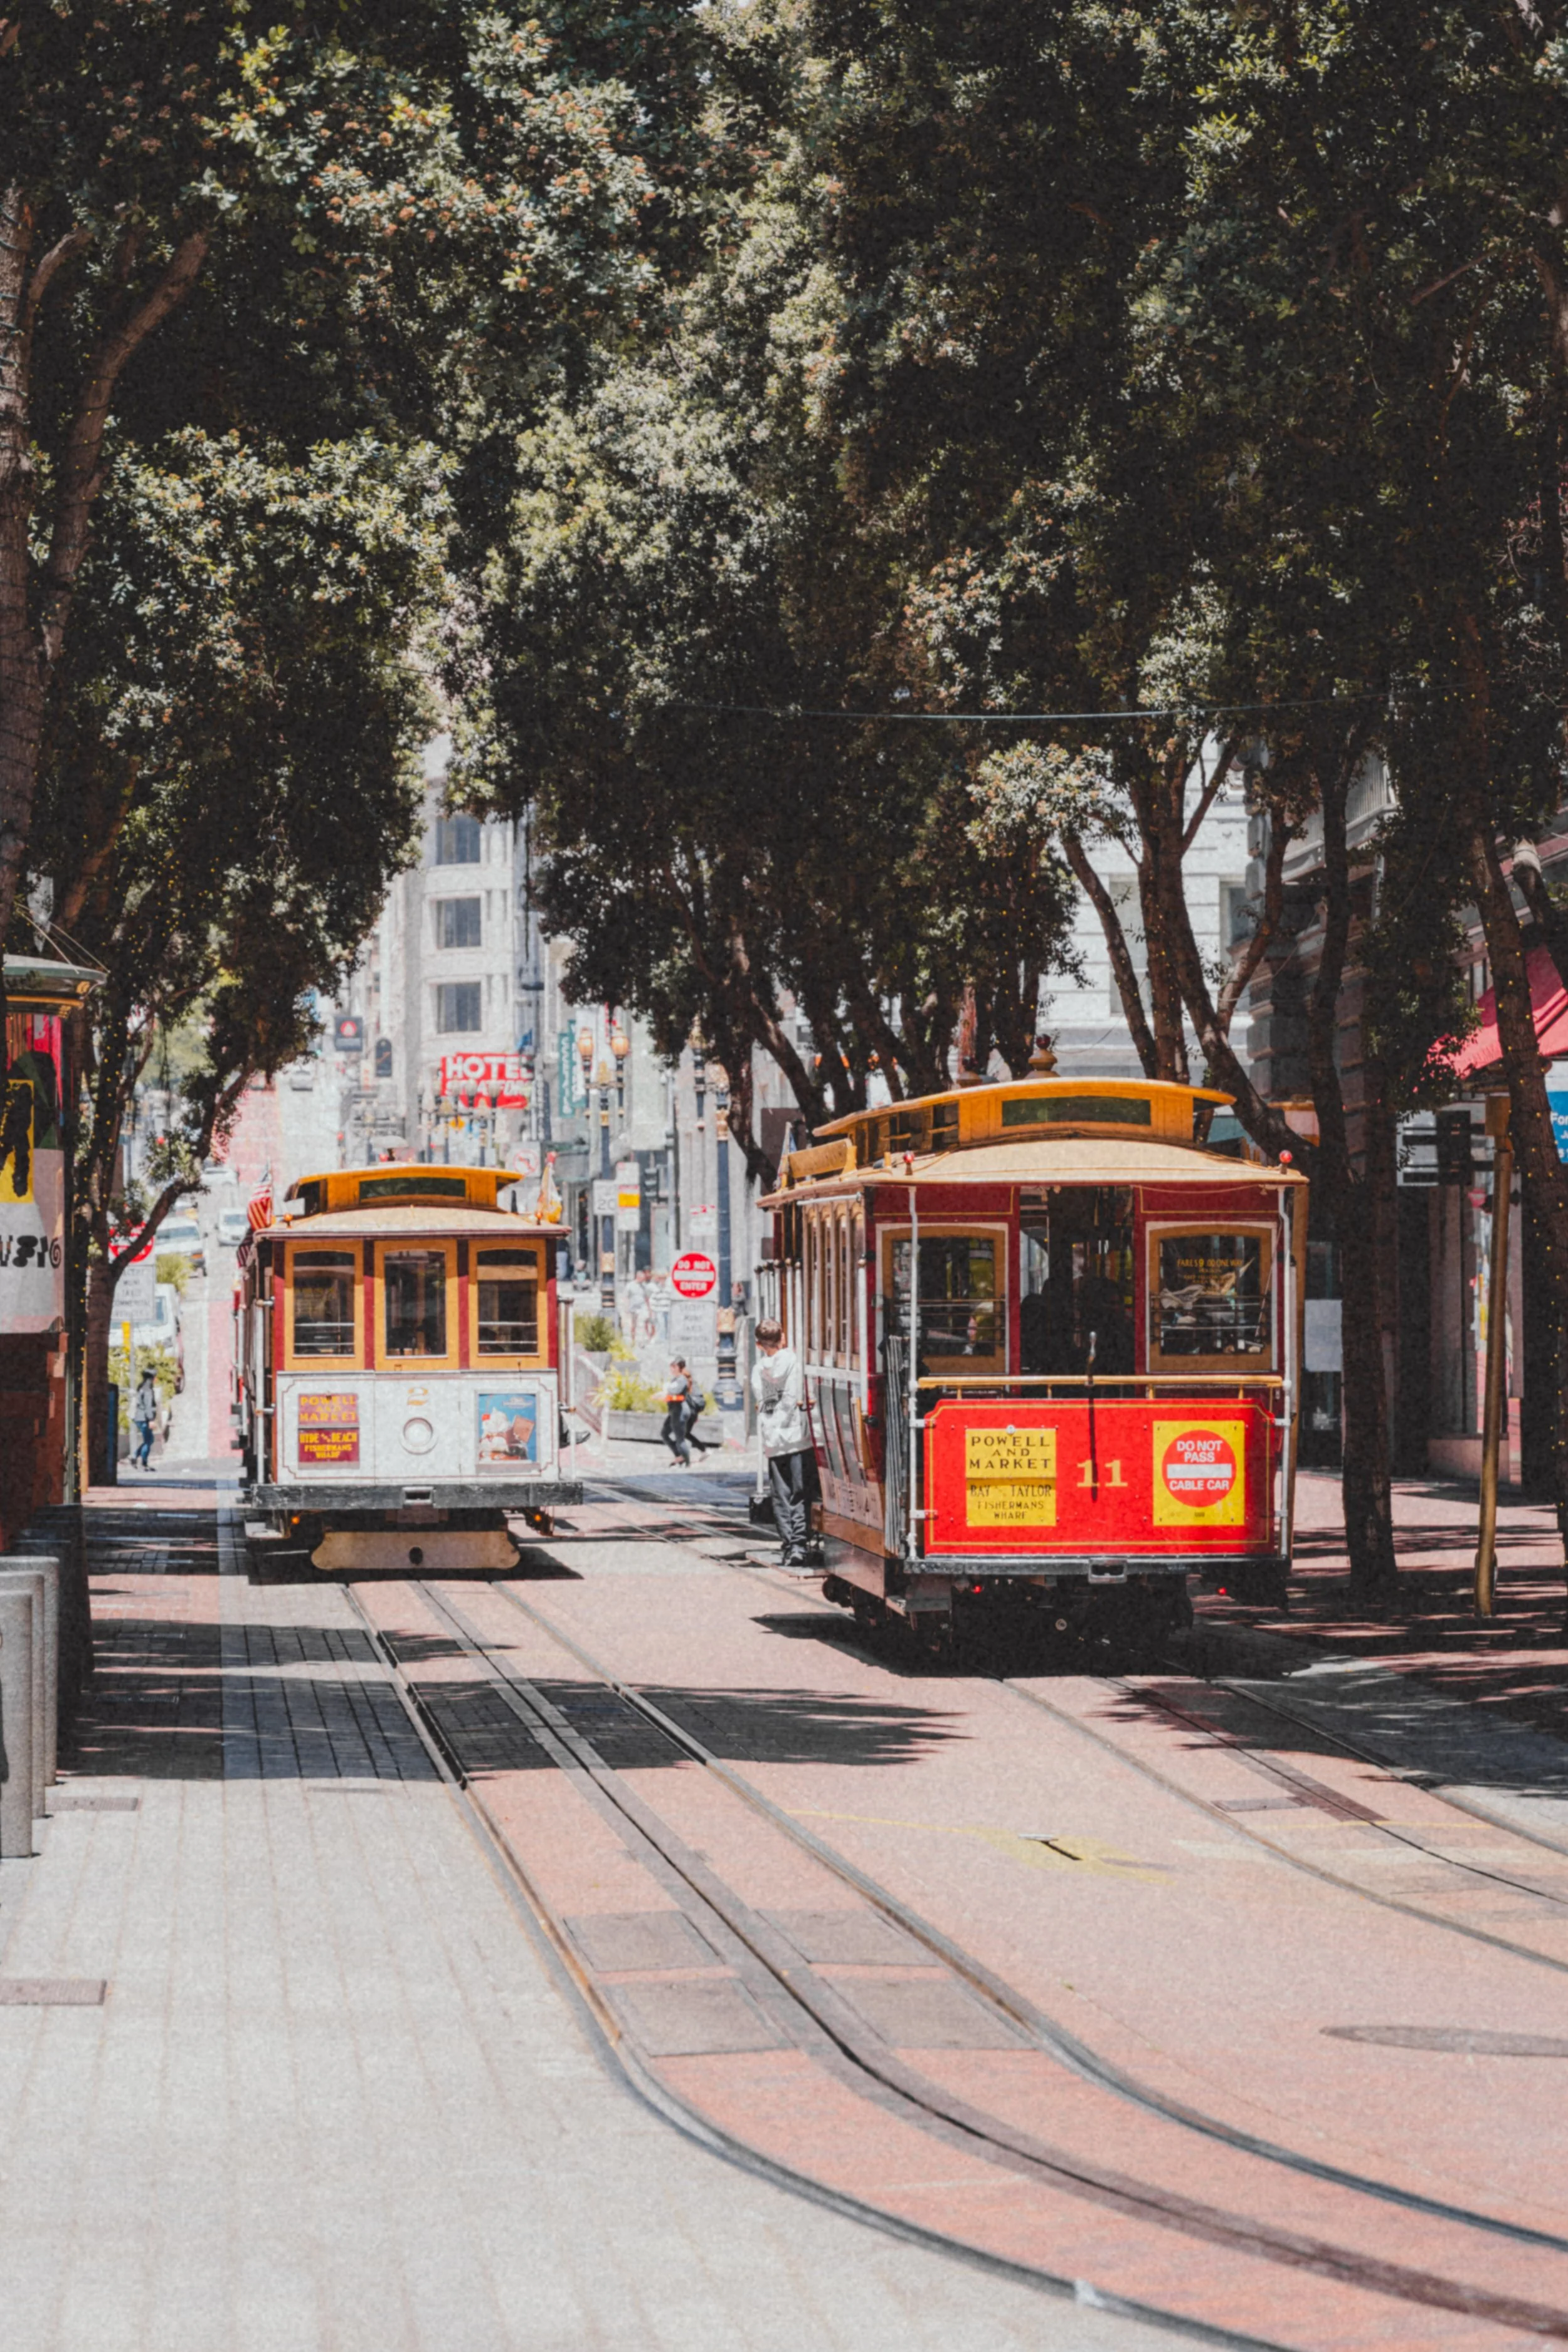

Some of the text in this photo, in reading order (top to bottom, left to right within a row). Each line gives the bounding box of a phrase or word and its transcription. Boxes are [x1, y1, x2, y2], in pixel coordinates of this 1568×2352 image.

[447, 1056, 533, 1079] HOTEL
[678, 1261, 710, 1270] DO NOT
[680, 1281, 707, 1291] ENTER
[300, 1396, 356, 1406] POWELL
[407, 1387, 428, 1406] 2
[300, 1411, 356, 1422] MARKET
[972, 1436, 1051, 1447] POWELL
[1177, 1440, 1222, 1451] DO NOT
[992, 1448, 1030, 1456] AND
[1184, 1452, 1215, 1463] PASS
[969, 1458, 1051, 1469] MARKET
[1077, 1459, 1128, 1487] 11
[970, 1485, 990, 1497] BAY
[1010, 1485, 1052, 1497] TAYLOR
[1169, 1480, 1229, 1491] CABLE CAR
[977, 1501, 1044, 1510] FISHERMANS
[994, 1511, 1027, 1520] WHARF
